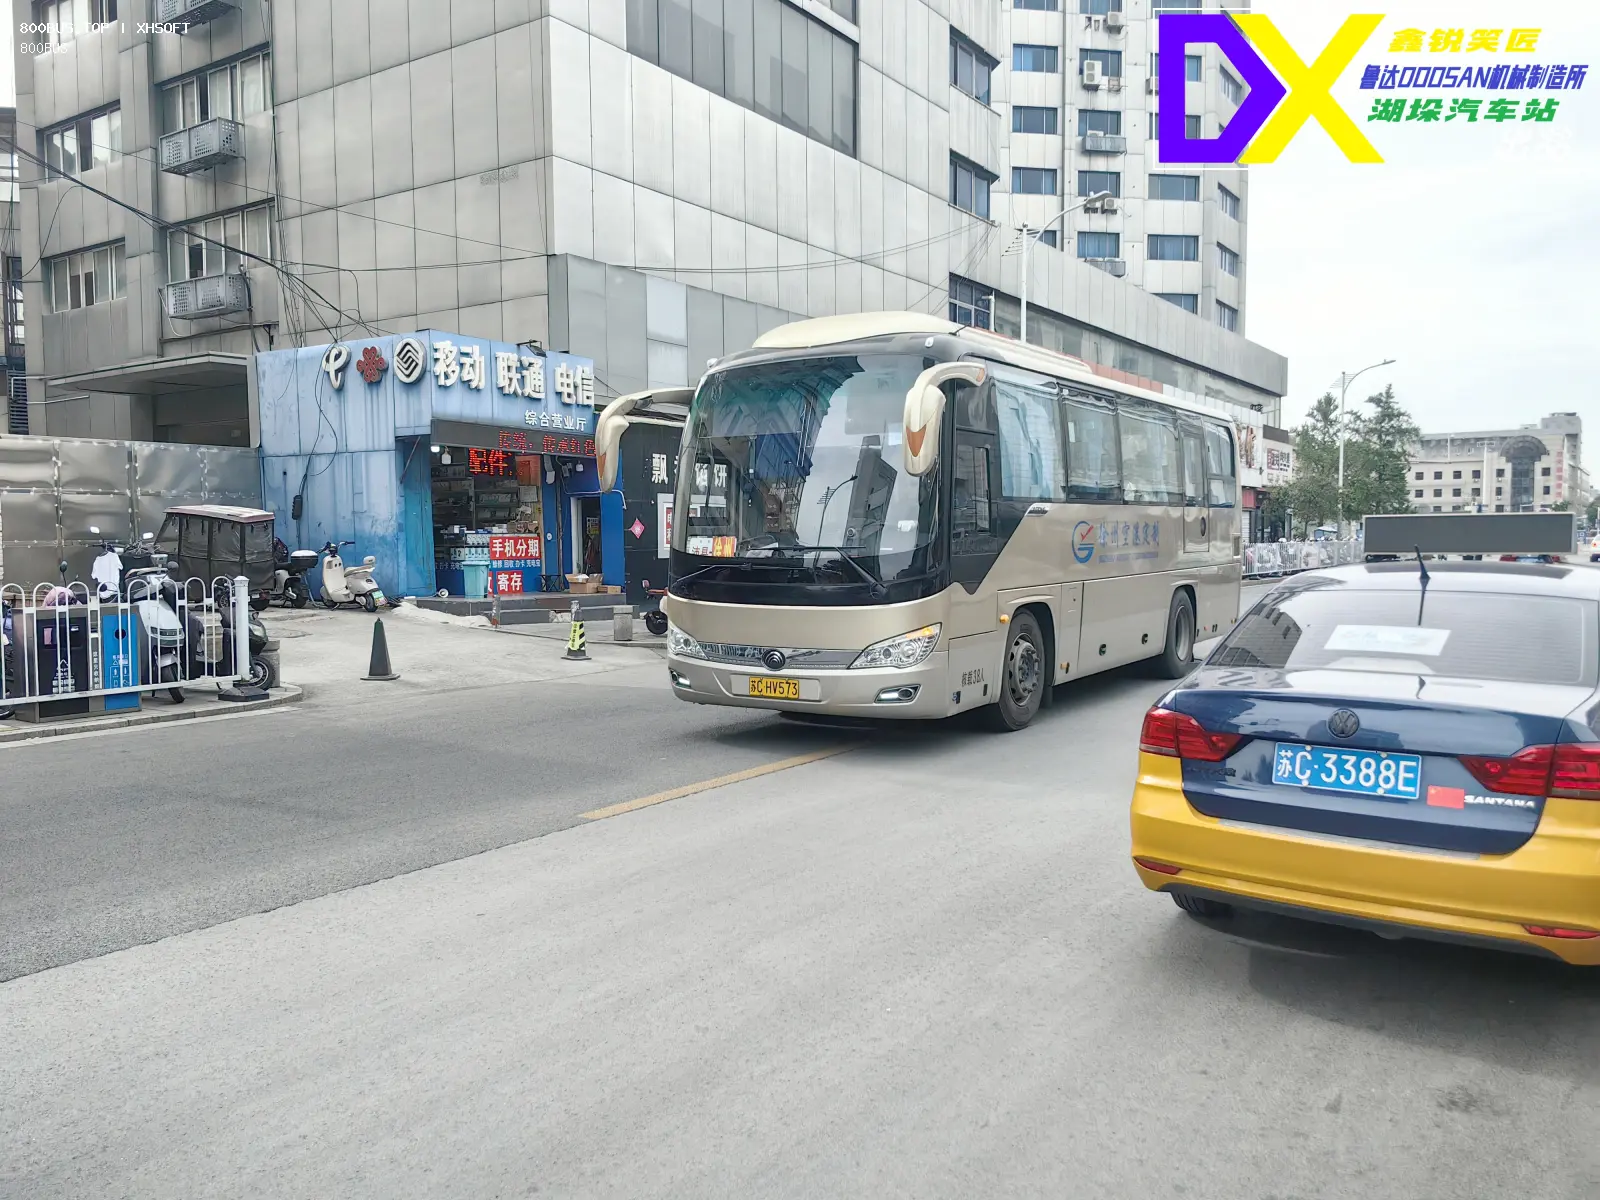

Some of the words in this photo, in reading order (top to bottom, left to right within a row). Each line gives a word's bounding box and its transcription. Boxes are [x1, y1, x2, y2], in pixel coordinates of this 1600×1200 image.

[433, 340, 485, 389] 移动
[495, 351, 545, 399] 联通
[554, 362, 594, 406] 电信
[524, 409, 586, 431] 综合营业厅
[491, 539, 540, 557] 手机分期
[497, 572, 522, 592] 寄存
[1463, 794, 1536, 809] SANTANA
